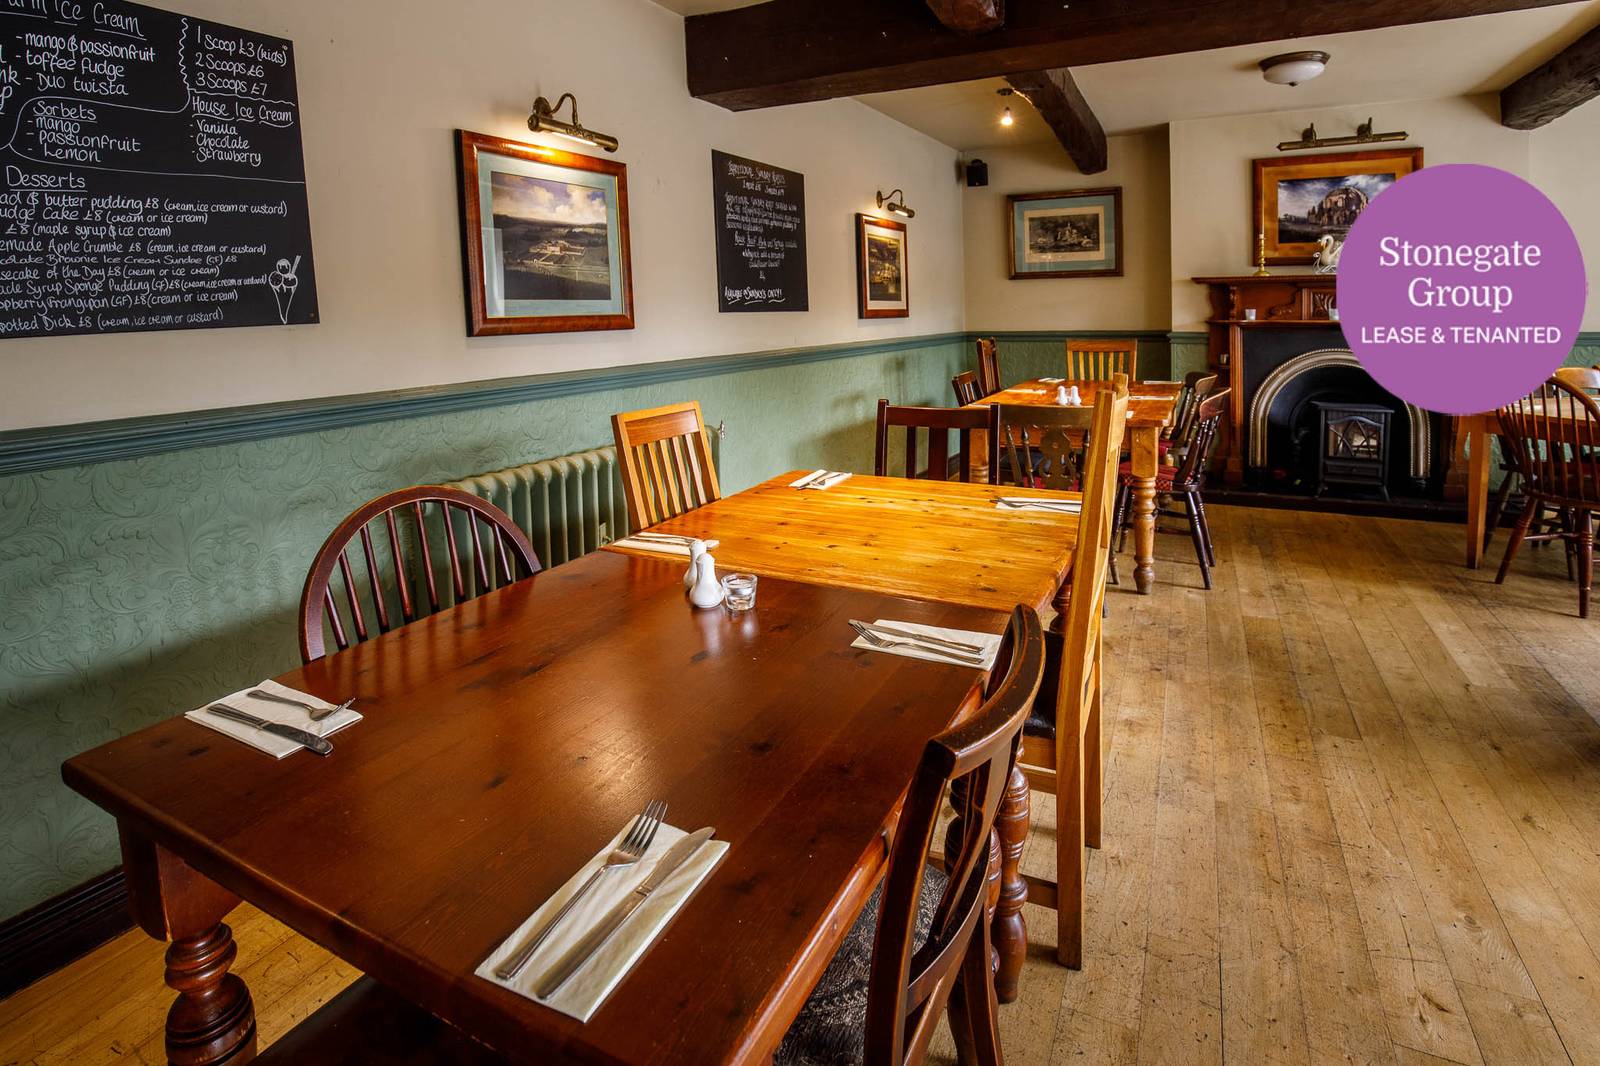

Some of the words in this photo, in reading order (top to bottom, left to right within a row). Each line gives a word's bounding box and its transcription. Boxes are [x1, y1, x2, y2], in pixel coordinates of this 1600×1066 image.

[93, 2, 145, 37] Cream
[26, 50, 77, 73] toffee
[81, 57, 125, 82] fudge
[195, 52, 204, 67] 2
[73, 76, 129, 95] twista
[195, 71, 206, 86] 3
[33, 100, 97, 120] Sorbets
[192, 96, 230, 117] House
[259, 105, 293, 122] Cream
[196, 119, 238, 135] Vanilla
[196, 132, 250, 150] Chocolate
[196, 147, 261, 167] Strawberry
[6, 165, 86, 189] Desserts
[42, 206, 80, 220] Cake
[45, 193, 87, 208] butter
[91, 195, 143, 215] pudding
[75, 227, 106, 240] syrup
[83, 240, 124, 253] Crumble
[46, 265, 59, 279] of
[62, 263, 80, 278] the
[81, 264, 105, 282] Day
[26, 279, 63, 299] Syrup
[64, 279, 104, 297] Sponge
[108, 279, 150, 295] Pudding
[42, 314, 76, 331] Dick
